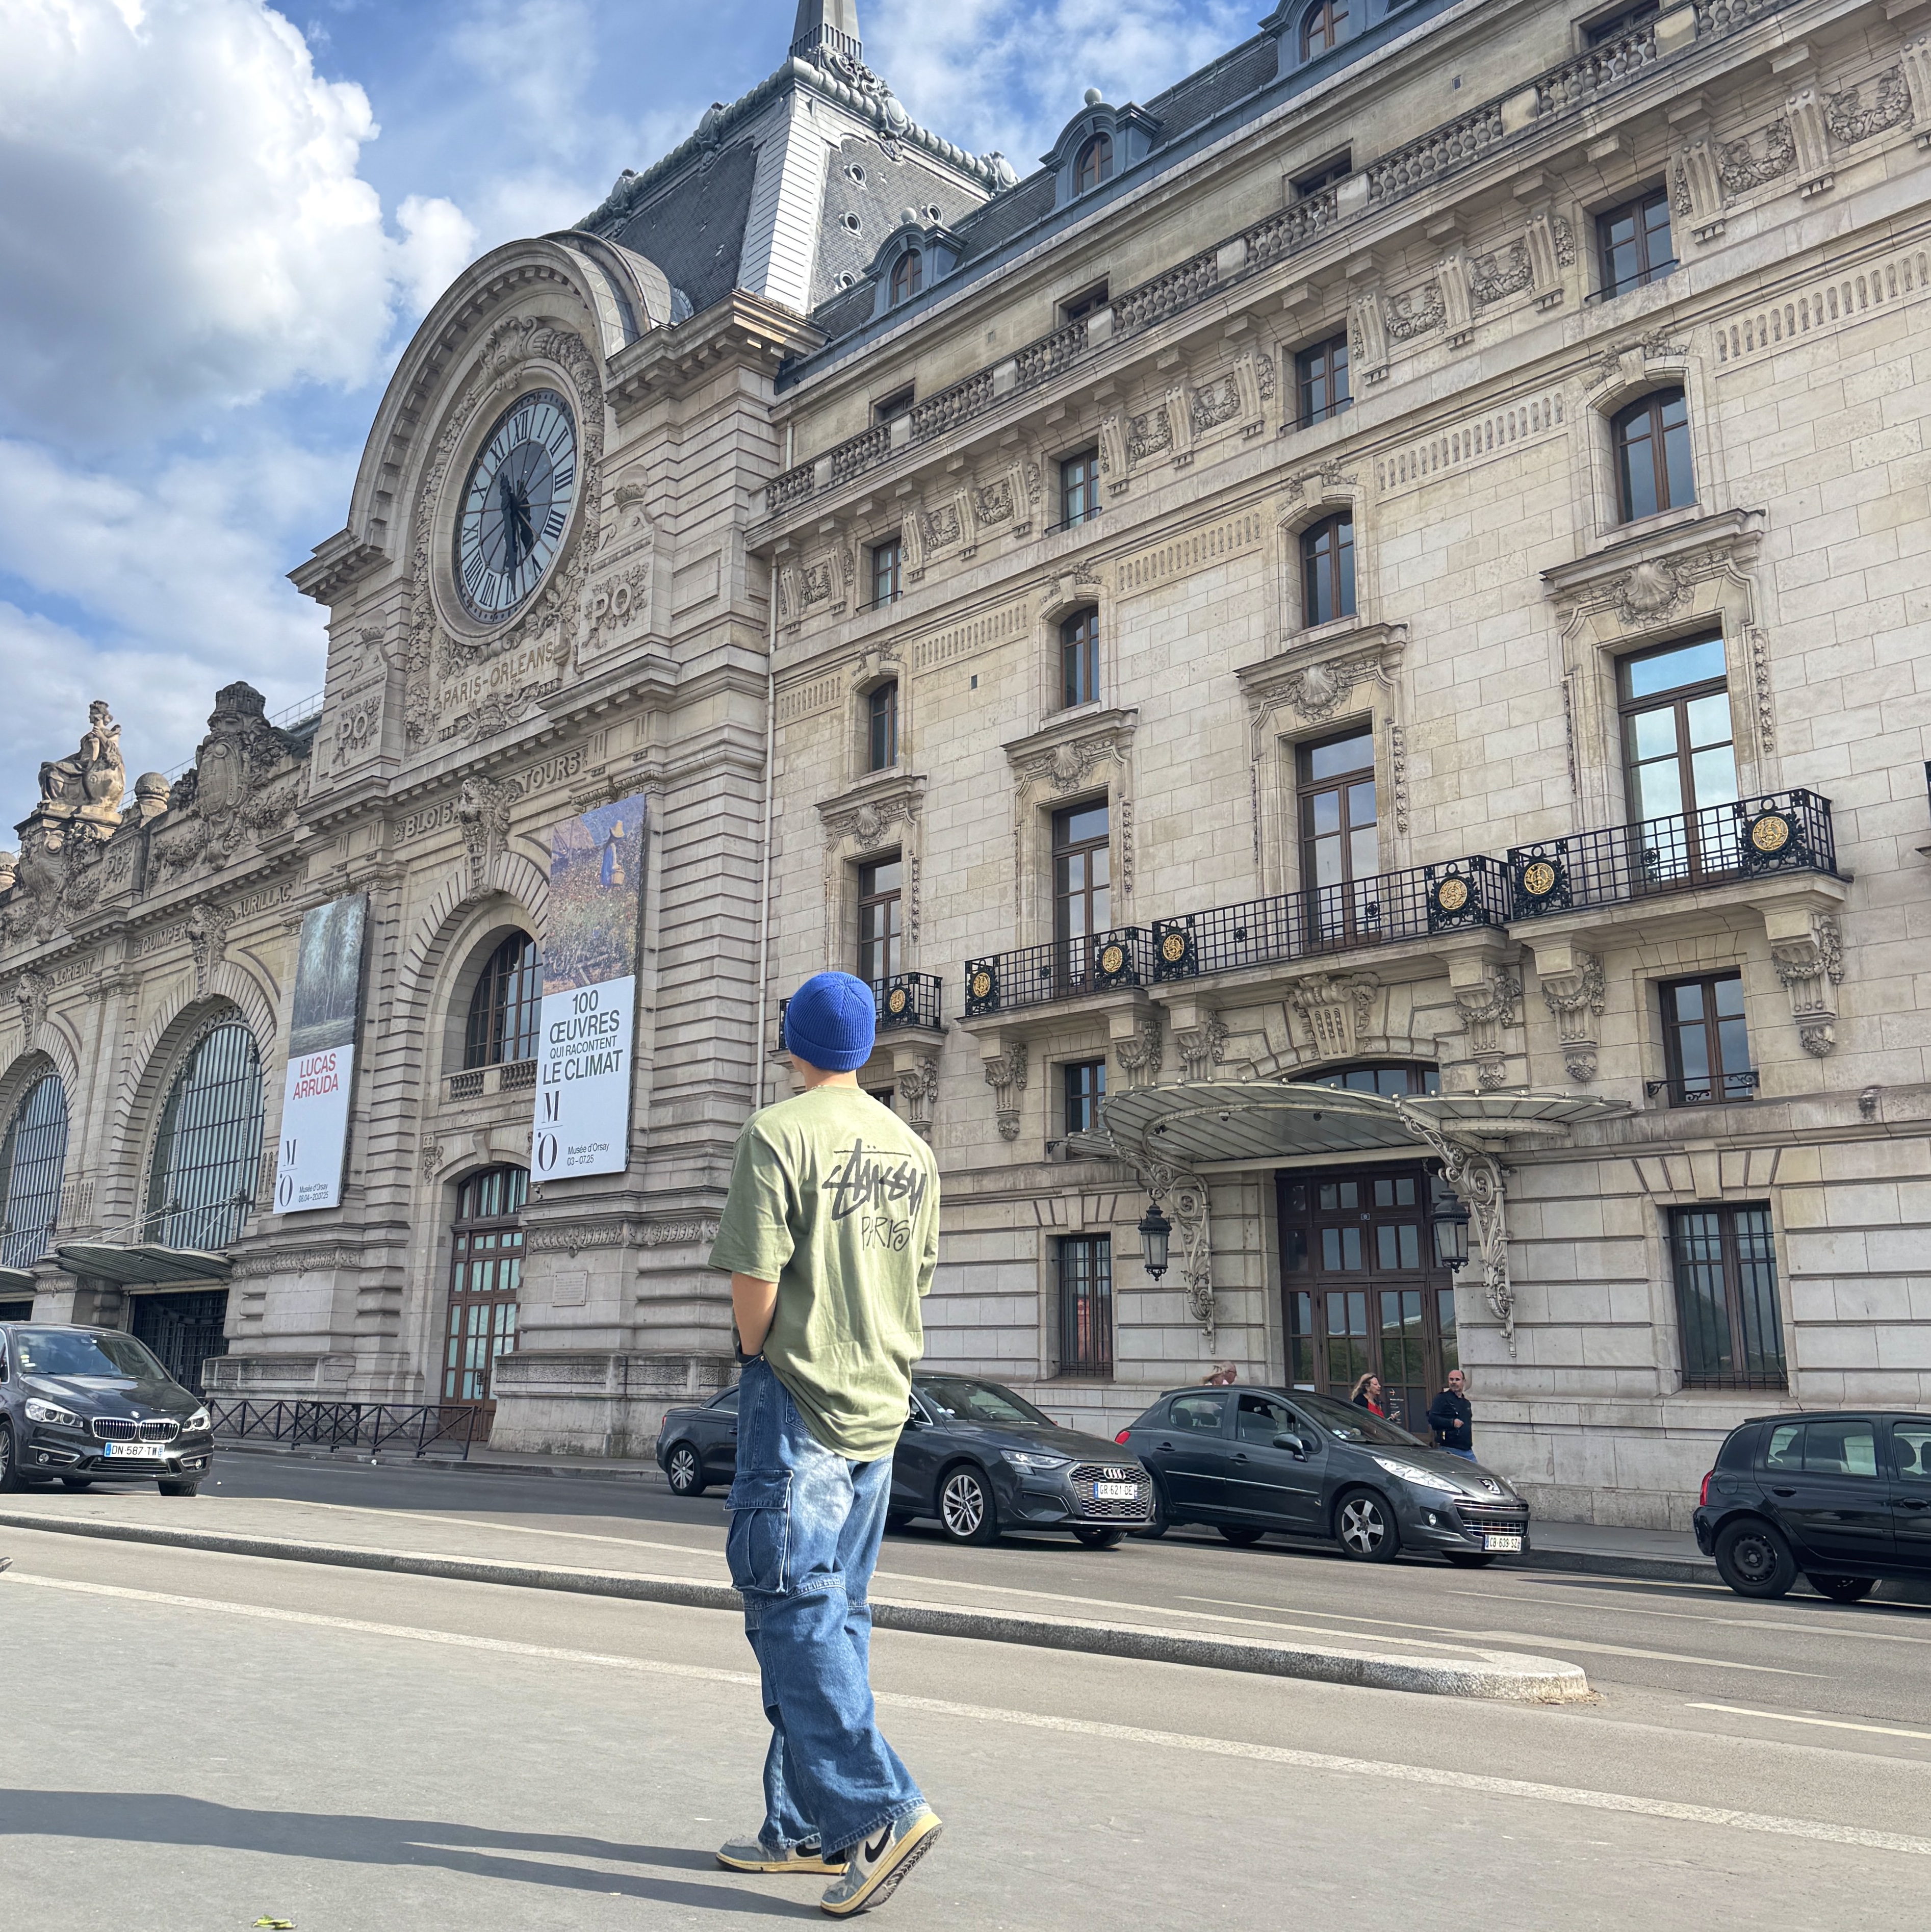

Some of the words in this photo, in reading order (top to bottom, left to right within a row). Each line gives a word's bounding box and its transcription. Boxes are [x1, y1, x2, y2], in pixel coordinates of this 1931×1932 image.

[513, 409, 529, 446] XII
[489, 435, 506, 469] XI
[471, 480, 488, 500] X
[554, 465, 574, 494] III
[462, 520, 479, 548] IX
[531, 554, 544, 580] V
[590, 582, 632, 629] PO
[443, 641, 553, 710] PARIS-ORLEANS
[340, 711, 368, 748] PO
[407, 802, 453, 838] BLOIS
[523, 752, 580, 793] TOURS
[142, 921, 189, 952] QUIMPER
[236, 883, 293, 920] AURILLAC
[56, 957, 95, 986] LORIENT
[572, 989, 599, 1015] 100
[549, 1010, 620, 1044] ŒUVRES
[550, 1046, 564, 1059] QUI
[565, 1035, 617, 1057] RACONTENT
[300, 1052, 337, 1078] LUCAS
[543, 1061, 562, 1085] LE
[564, 1049, 623, 1080] CLIMAT
[293, 1073, 339, 1100] ARRUDA
[542, 1090, 561, 1123] M
[282, 1139, 298, 1166] M
[568, 1144, 587, 1155] Musée
[587, 1142, 609, 1152] d'Orsay
